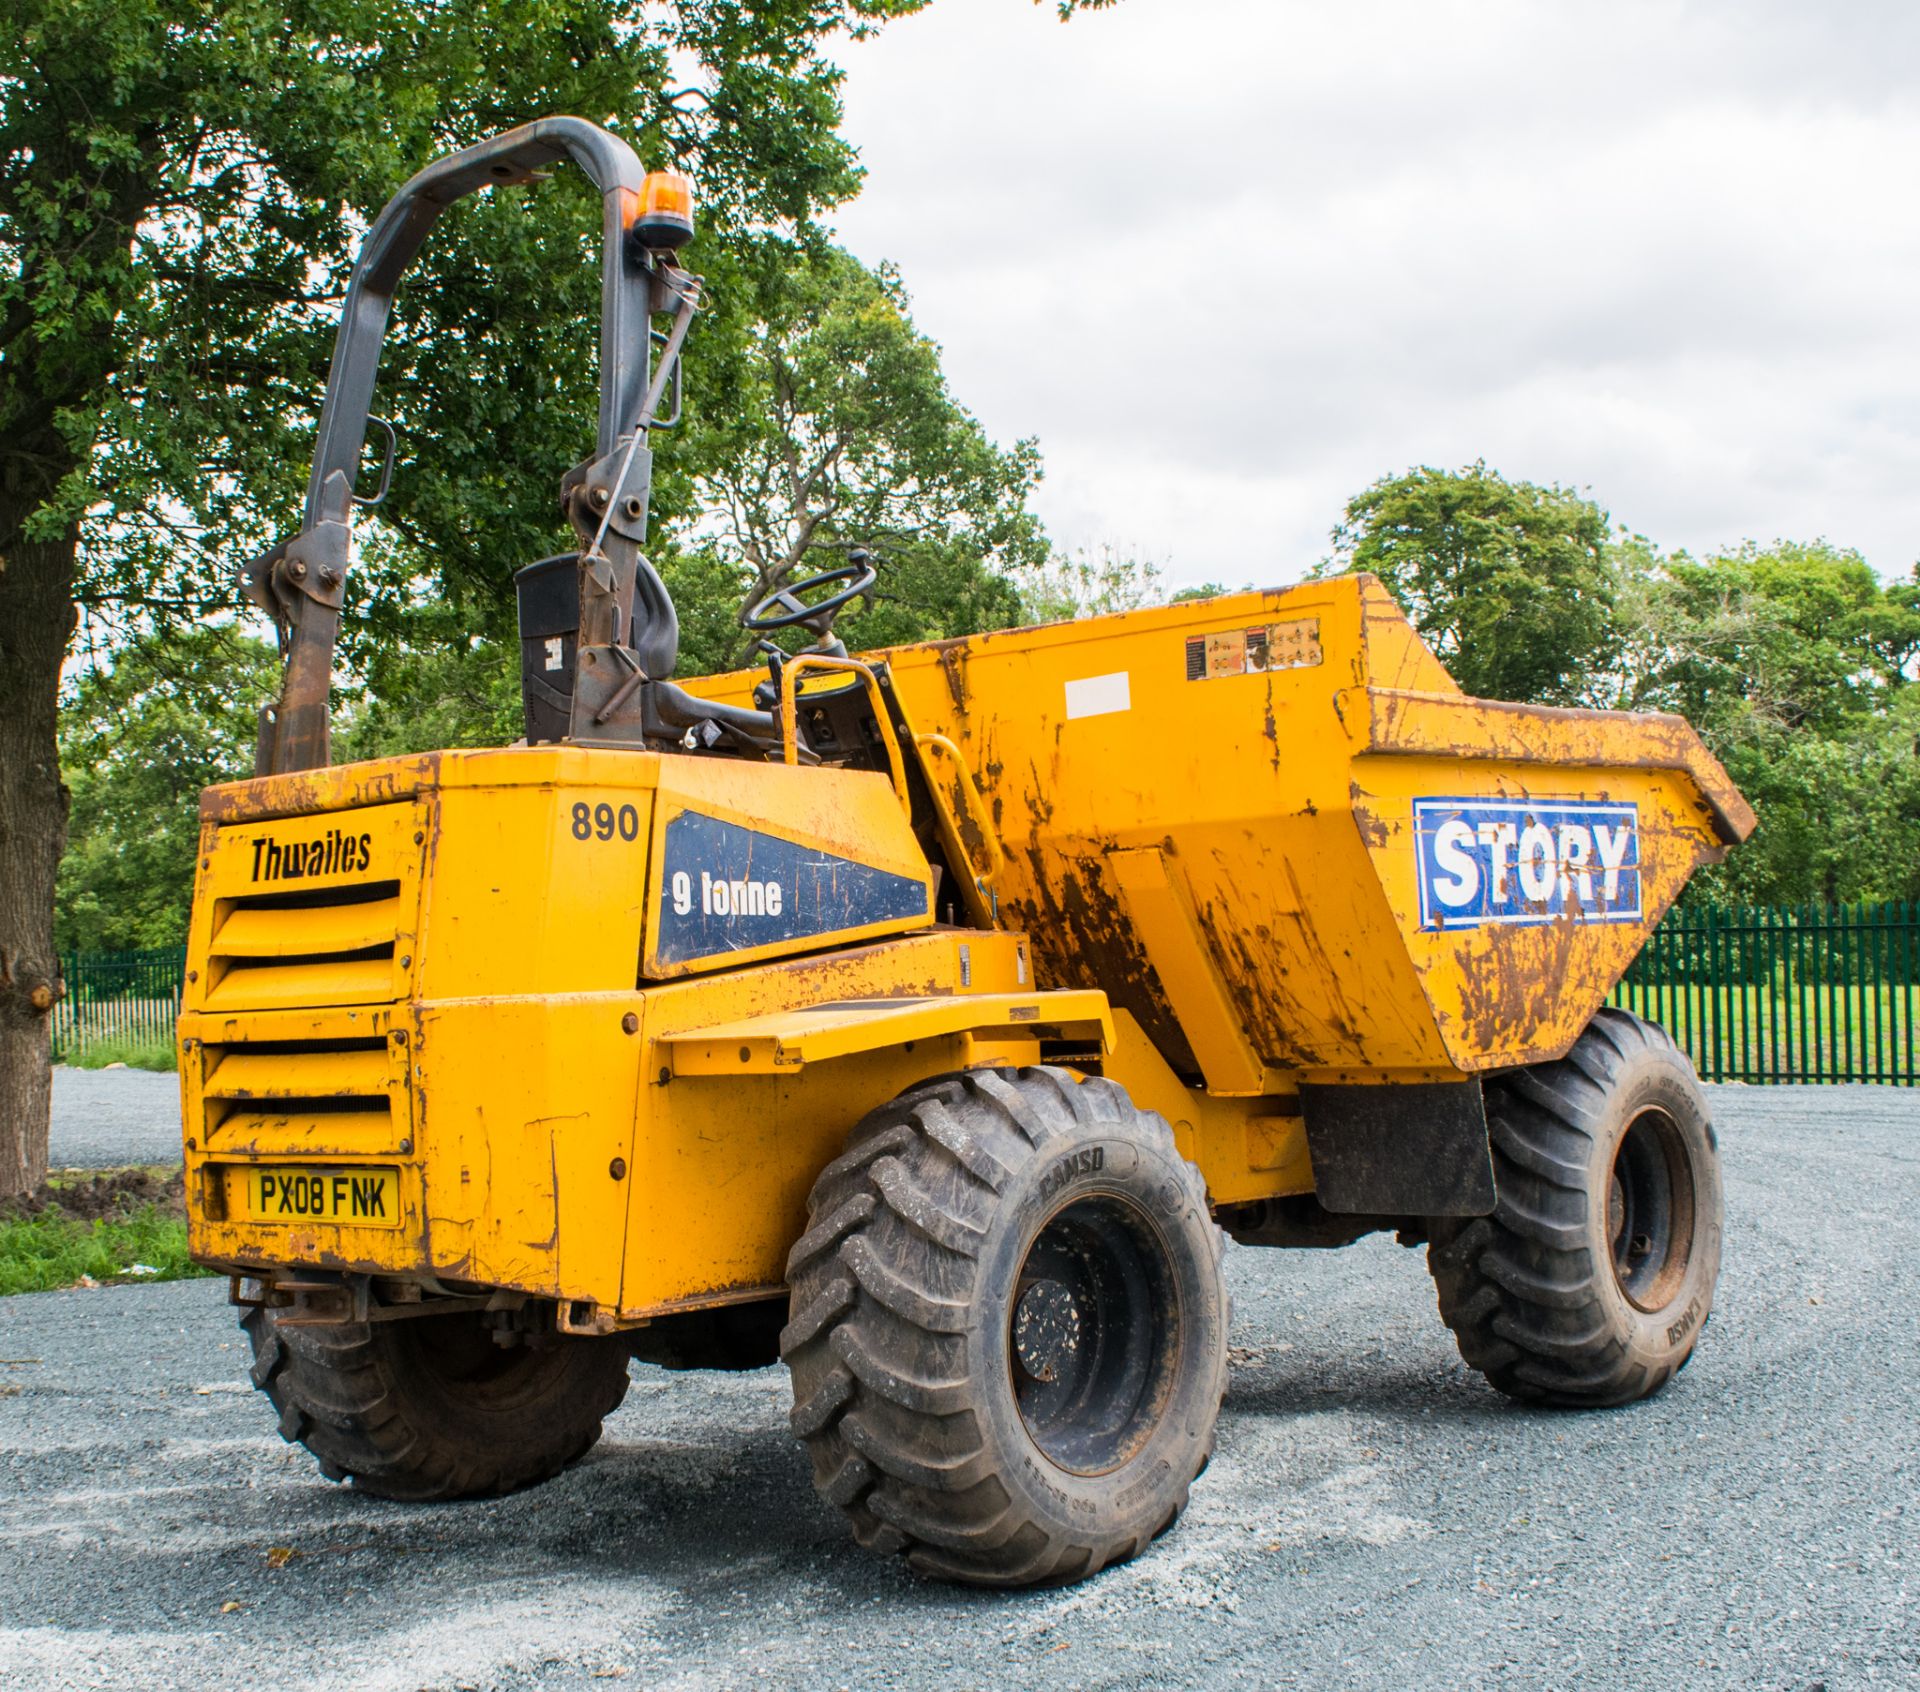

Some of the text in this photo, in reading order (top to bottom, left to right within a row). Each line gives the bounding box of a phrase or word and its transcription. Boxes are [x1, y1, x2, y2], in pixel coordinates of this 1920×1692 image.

[571, 802, 639, 842] 890
[251, 829, 371, 883] Thwaites
[1432, 820, 1633, 908] STORY
[672, 871, 783, 917] 9 tonne
[260, 1175, 386, 1217] PX08 FNK
